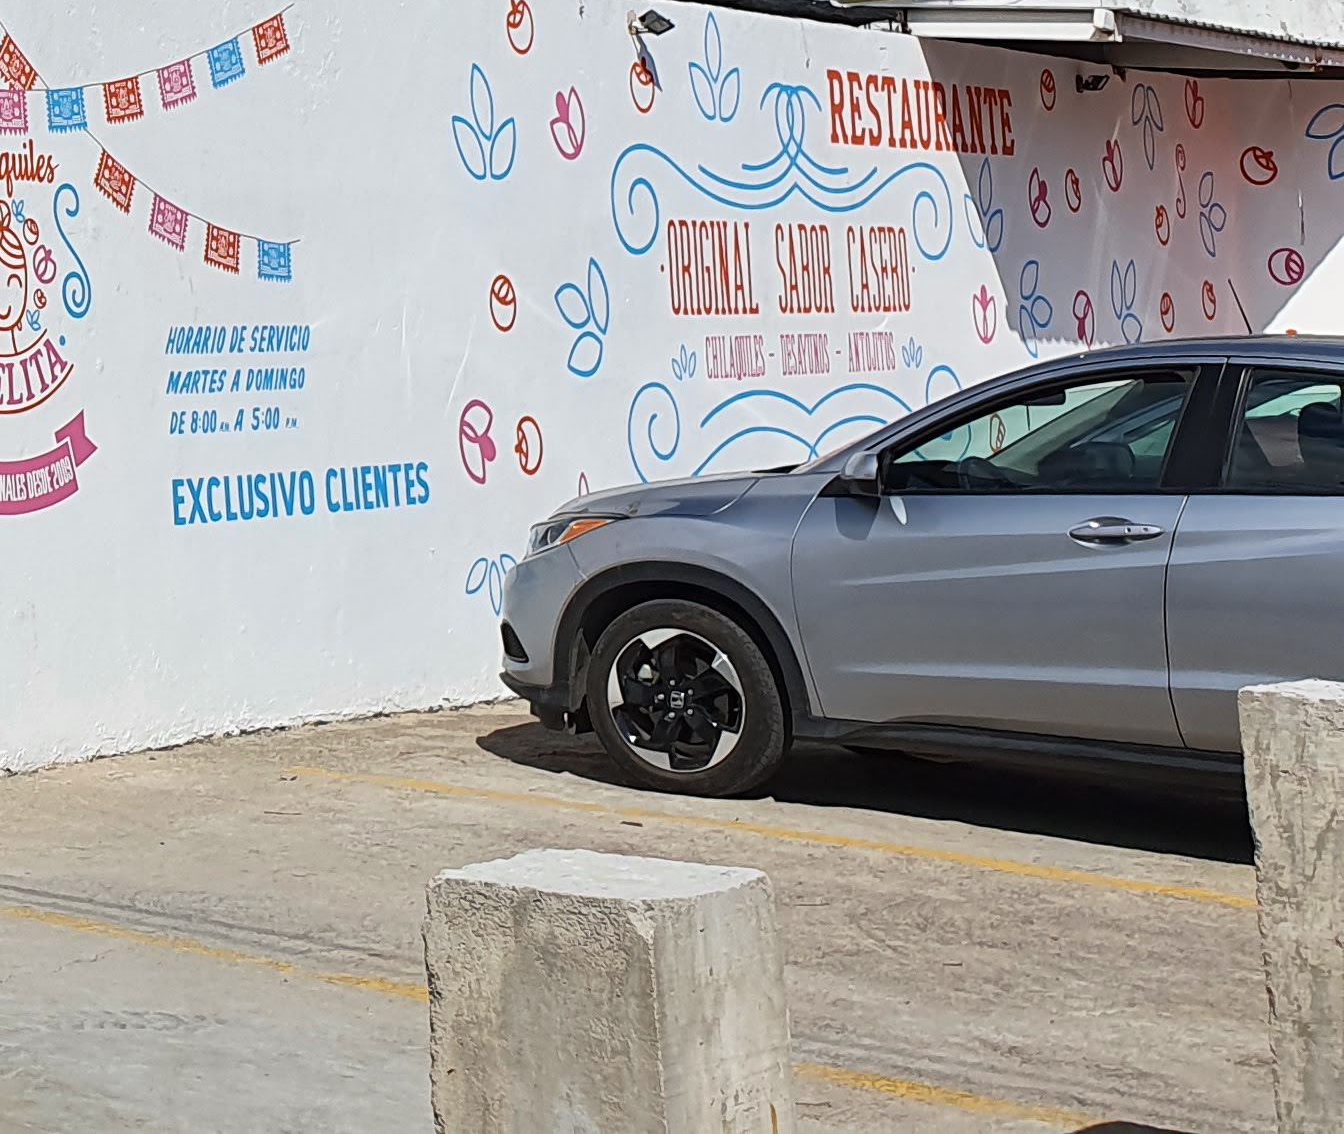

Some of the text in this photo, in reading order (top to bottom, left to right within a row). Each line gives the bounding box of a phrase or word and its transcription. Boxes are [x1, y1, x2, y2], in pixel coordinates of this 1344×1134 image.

[826, 68, 1016, 156] RESTAURANTE
[667, 219, 911, 315] ORIGINAL SABOR CASERO
[165, 324, 310, 354] HORARIO DE SERVICIO
[166, 367, 306, 394] MARTES A DOMINGO
[170, 411, 186, 434] DE
[190, 410, 217, 434] 8:00
[234, 408, 244, 431] A
[251, 407, 280, 430] 5:00
[26, 466, 53, 498] DESDE
[172, 462, 430, 525] EXCLUSIVO CLIENTES
